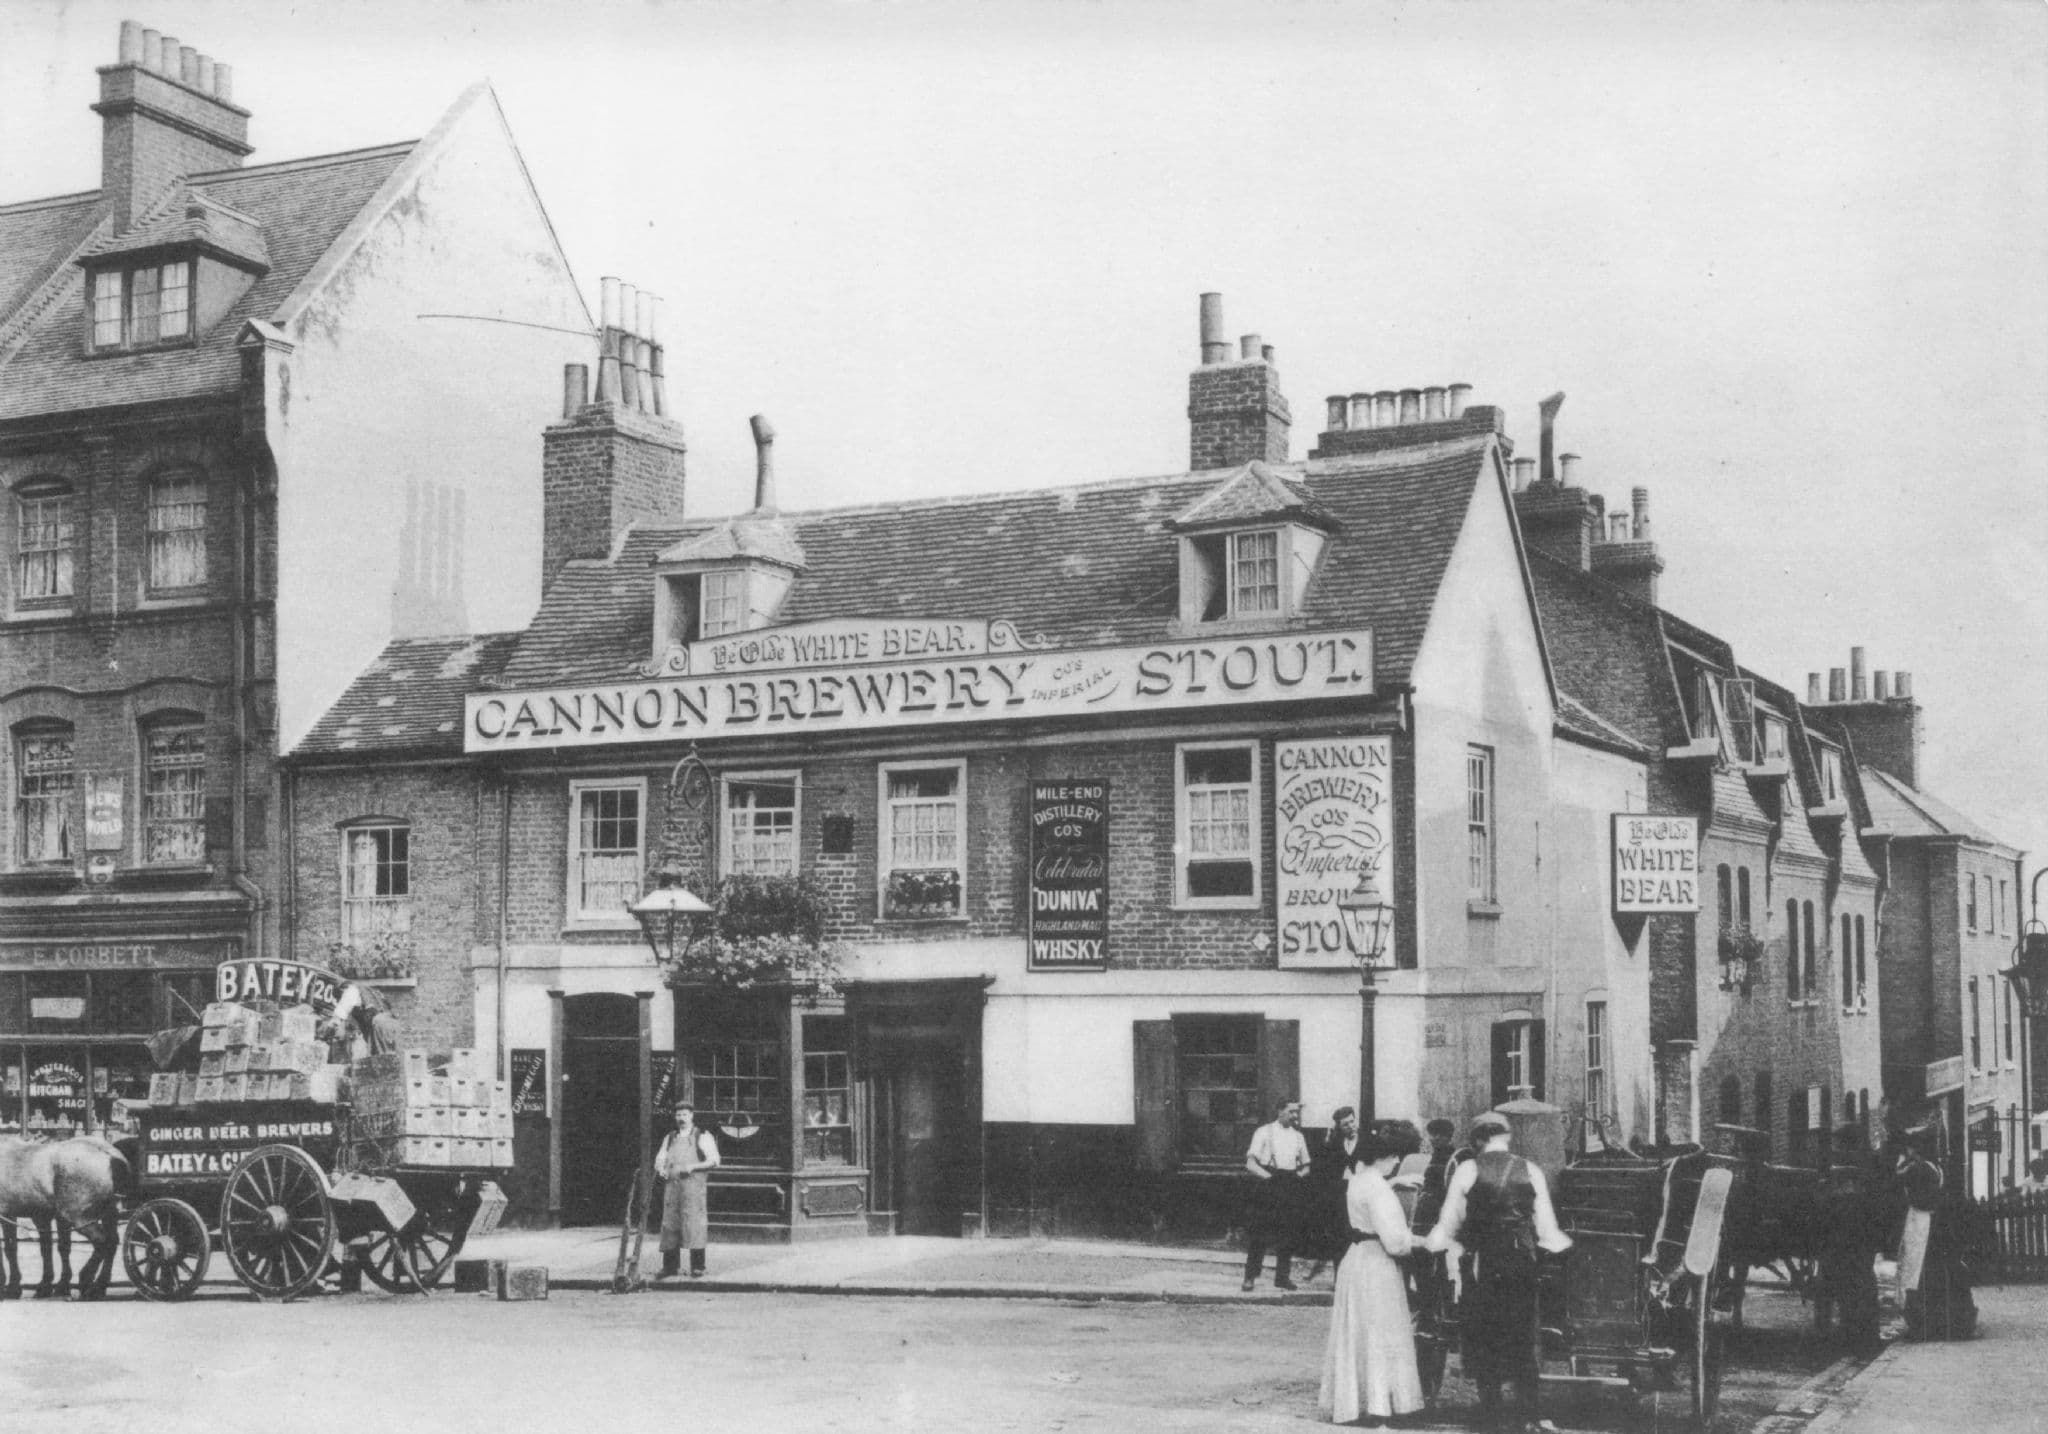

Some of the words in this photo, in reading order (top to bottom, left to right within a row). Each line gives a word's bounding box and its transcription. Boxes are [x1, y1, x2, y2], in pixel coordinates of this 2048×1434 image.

[791, 632, 869, 662] WHITE
[1031, 666, 1113, 700] IMPERIAL
[475, 686, 708, 738] CANNON
[724, 661, 1035, 724] BREWERY
[1280, 745, 1387, 770] CANNON
[1036, 786, 1103, 800] MILE-END
[1279, 777, 1387, 823] BREWERY
[1034, 804, 1103, 826] DISTILLERY
[1281, 826, 1391, 879] Imperial
[1619, 848, 1694, 871] WHITE
[1620, 879, 1694, 904] BEAR
[220, 963, 315, 1001] BATEY
[150, 1127, 203, 1141] GINGER
[209, 1124, 250, 1139] BEER
[257, 1121, 332, 1138] BREWERS
[147, 1153, 206, 1174] BATEY
[208, 1155, 220, 1171] &
